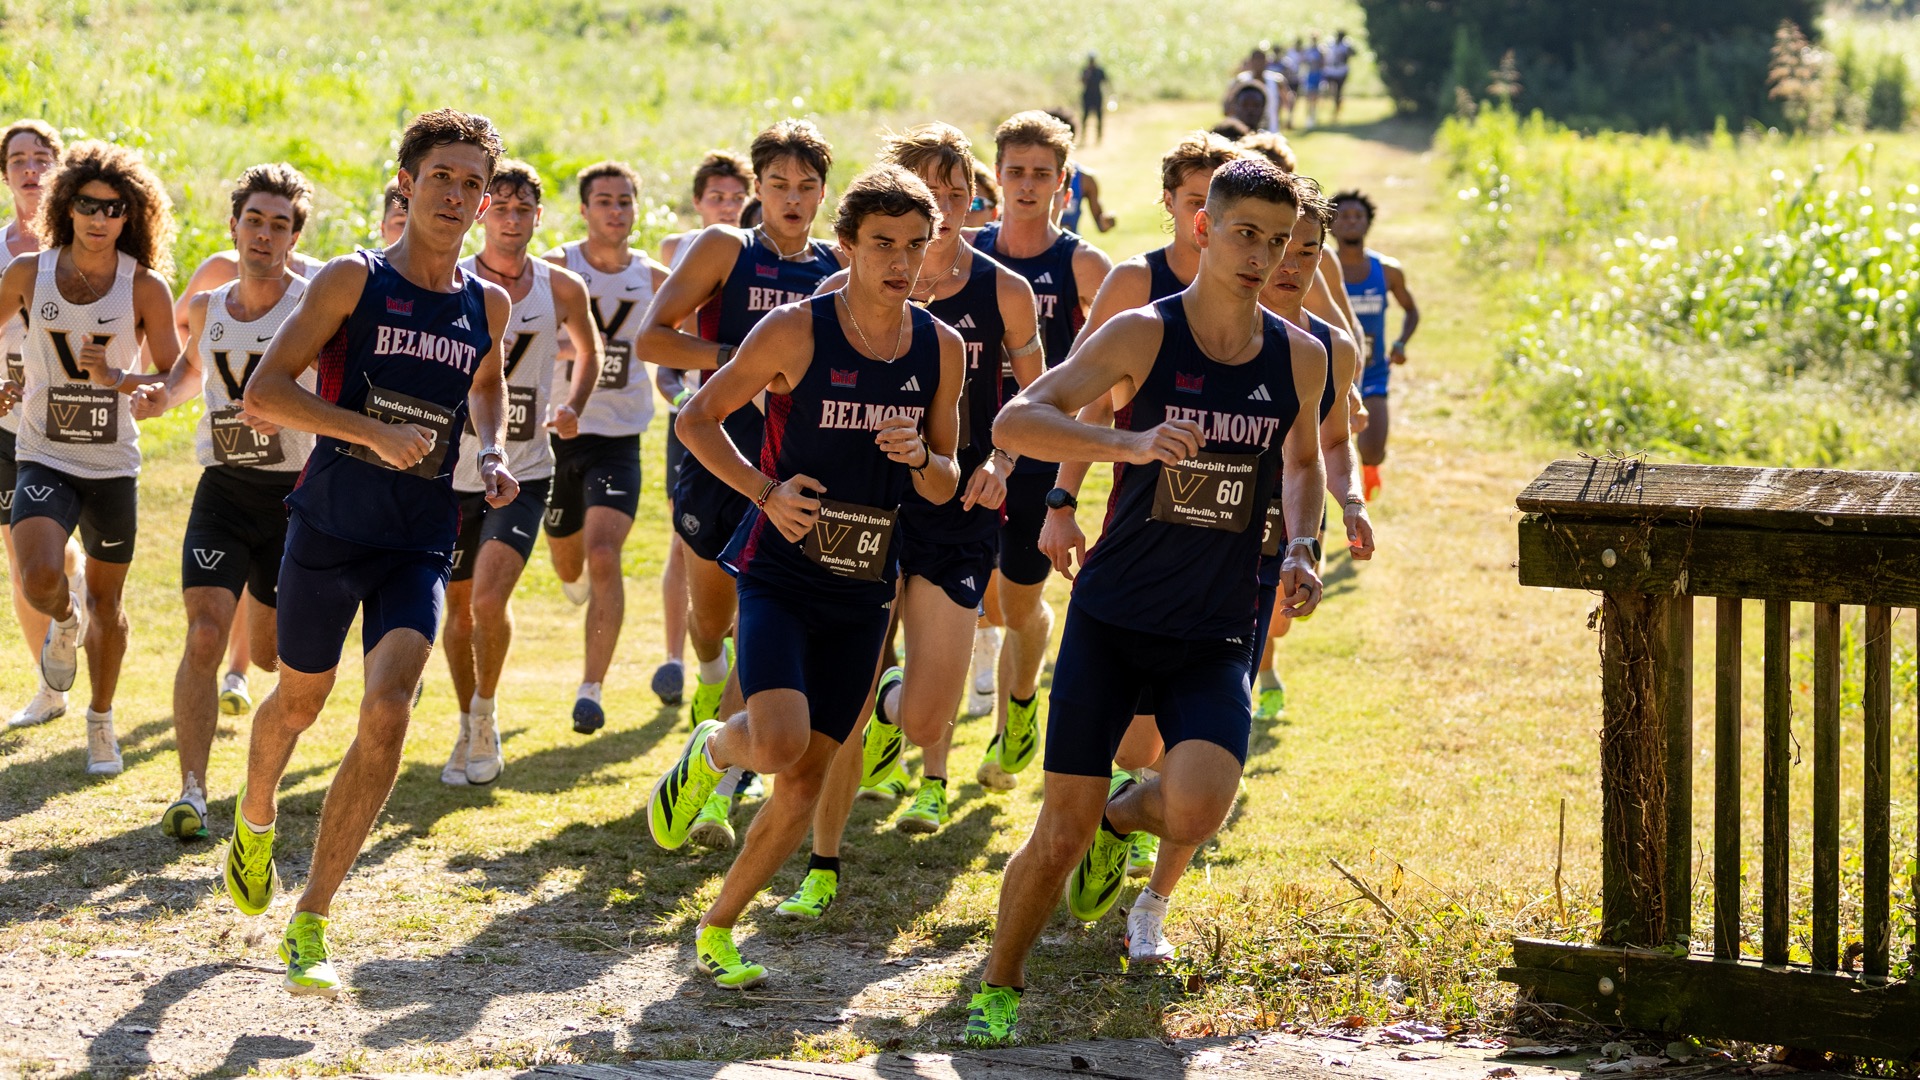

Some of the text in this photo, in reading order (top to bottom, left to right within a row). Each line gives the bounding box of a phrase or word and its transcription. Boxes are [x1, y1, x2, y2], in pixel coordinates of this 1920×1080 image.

[374, 325, 476, 376] BELMONT
[603, 355, 623, 374] 25
[52, 393, 114, 404] Vanderbilt Invite
[90, 407, 108, 427] 19
[373, 395, 423, 418] Vanderbilt
[423, 410, 449, 426] Invite
[508, 404, 527, 424] 20
[1177, 459, 1253, 473] anderbilt Invite
[1216, 479, 1244, 506] 60
[820, 506, 891, 527] Vanderbilt Invite
[1173, 504, 1233, 520] Nashville, TN
[1267, 506, 1280, 516] vite
[857, 530, 881, 556] 64
[820, 555, 857, 567] Nashville,
[858, 560, 870, 569] TN
